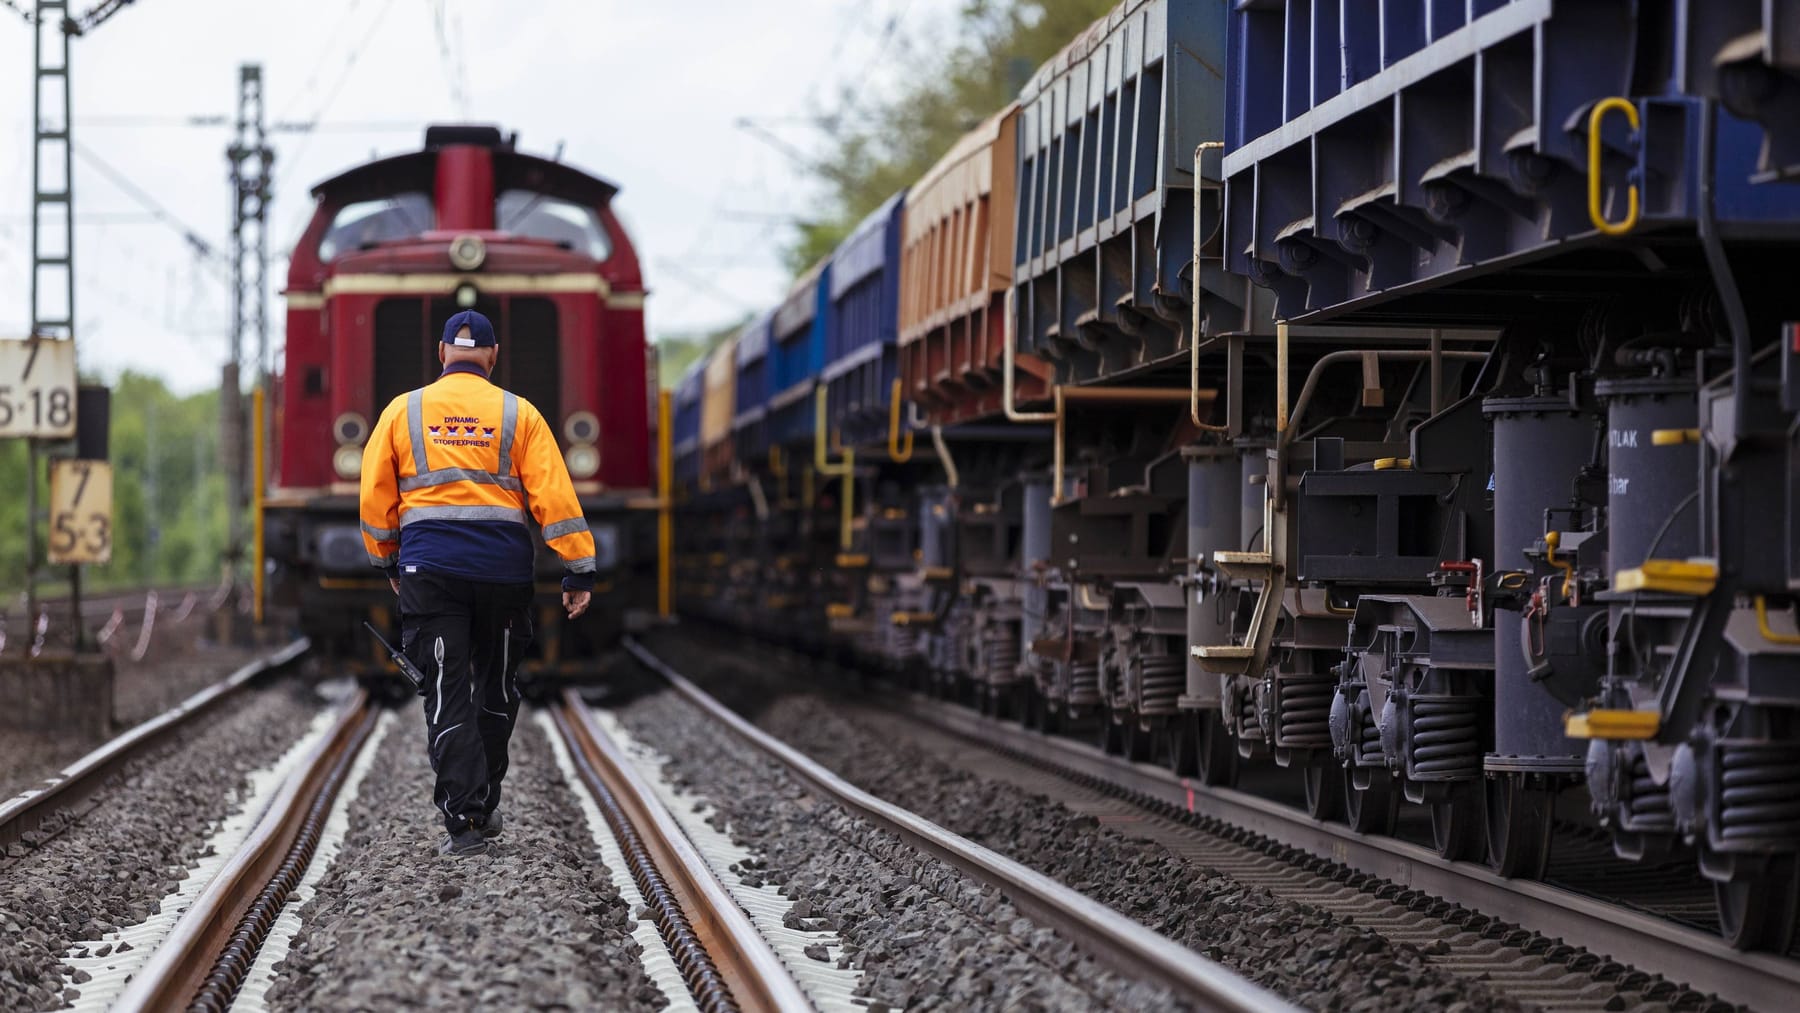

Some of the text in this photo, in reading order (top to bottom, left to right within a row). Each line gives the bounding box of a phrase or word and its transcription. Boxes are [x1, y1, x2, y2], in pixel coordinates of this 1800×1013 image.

[20, 339, 40, 381] 7
[444, 416, 480, 424] DYNAMIC
[433, 438, 490, 447] STOPFEXPRESS
[71, 463, 91, 508] 7
